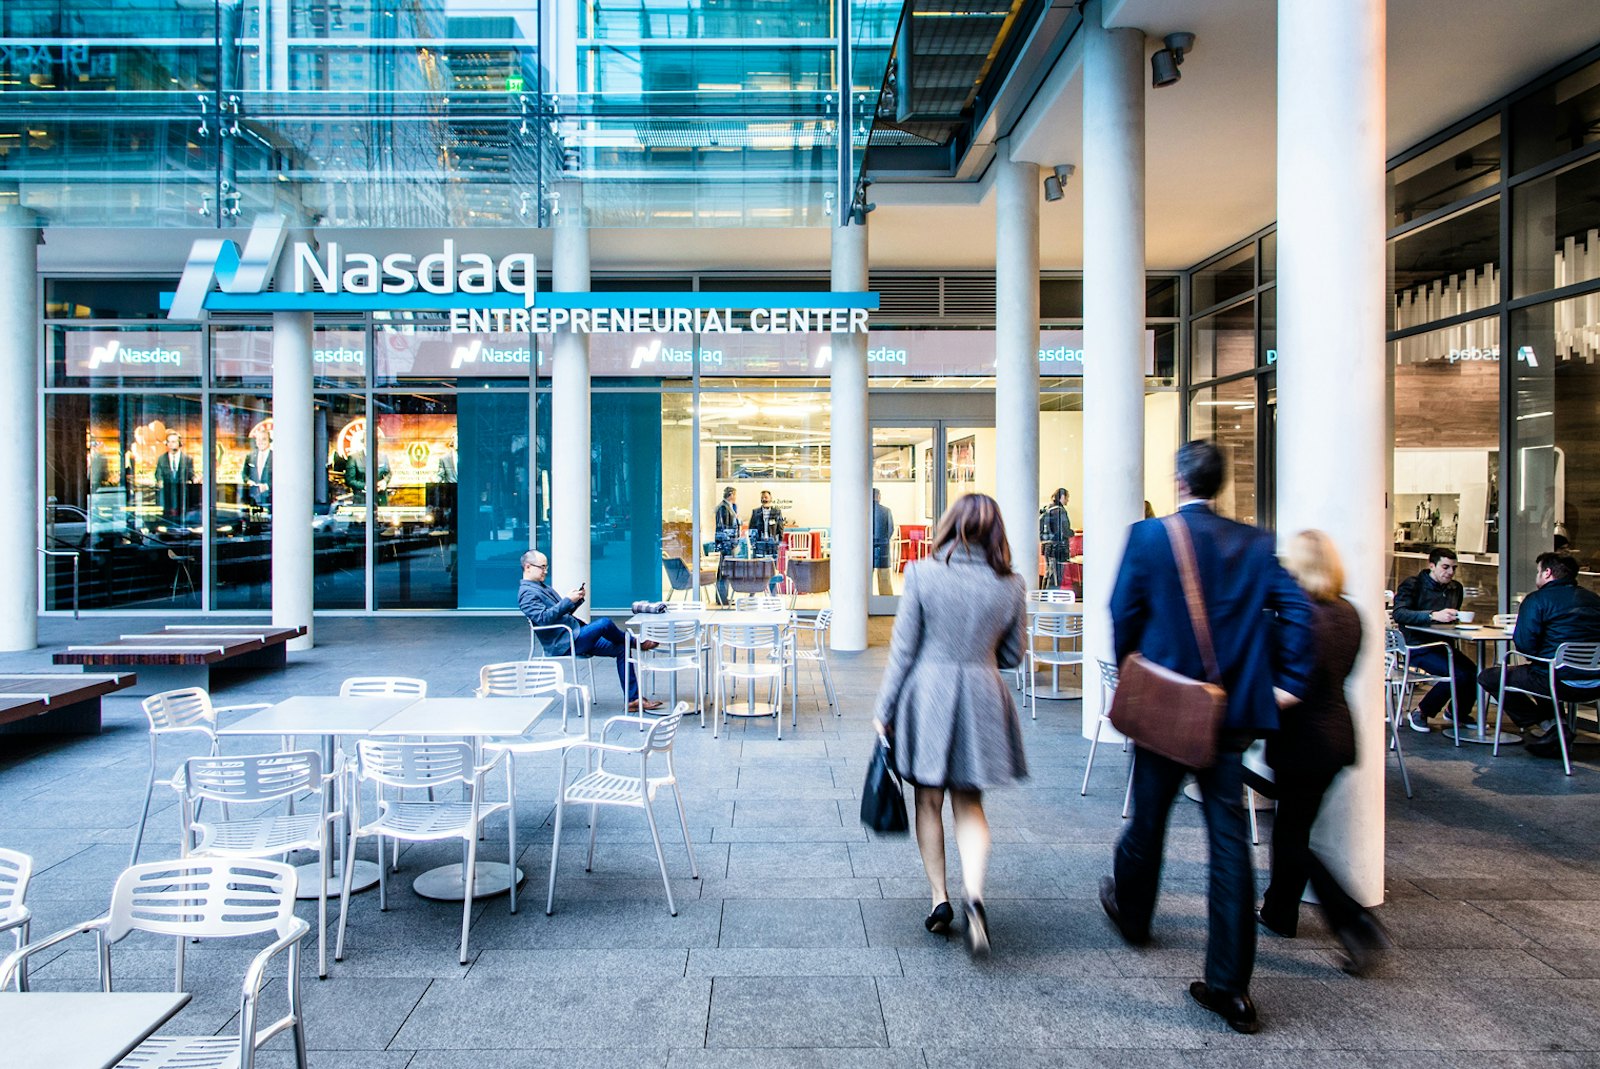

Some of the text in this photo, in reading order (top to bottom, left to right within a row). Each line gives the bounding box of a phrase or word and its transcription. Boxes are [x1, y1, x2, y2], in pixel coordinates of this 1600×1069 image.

[294, 239, 536, 308] Nasdaq
[450, 308, 870, 334] ENTREPRENEURIAL CENTER
[119, 347, 181, 366] Nasdaq
[314, 347, 364, 366] asdaq
[868, 347, 907, 365] sdaq
[1038, 346, 1084, 365] asdaq
